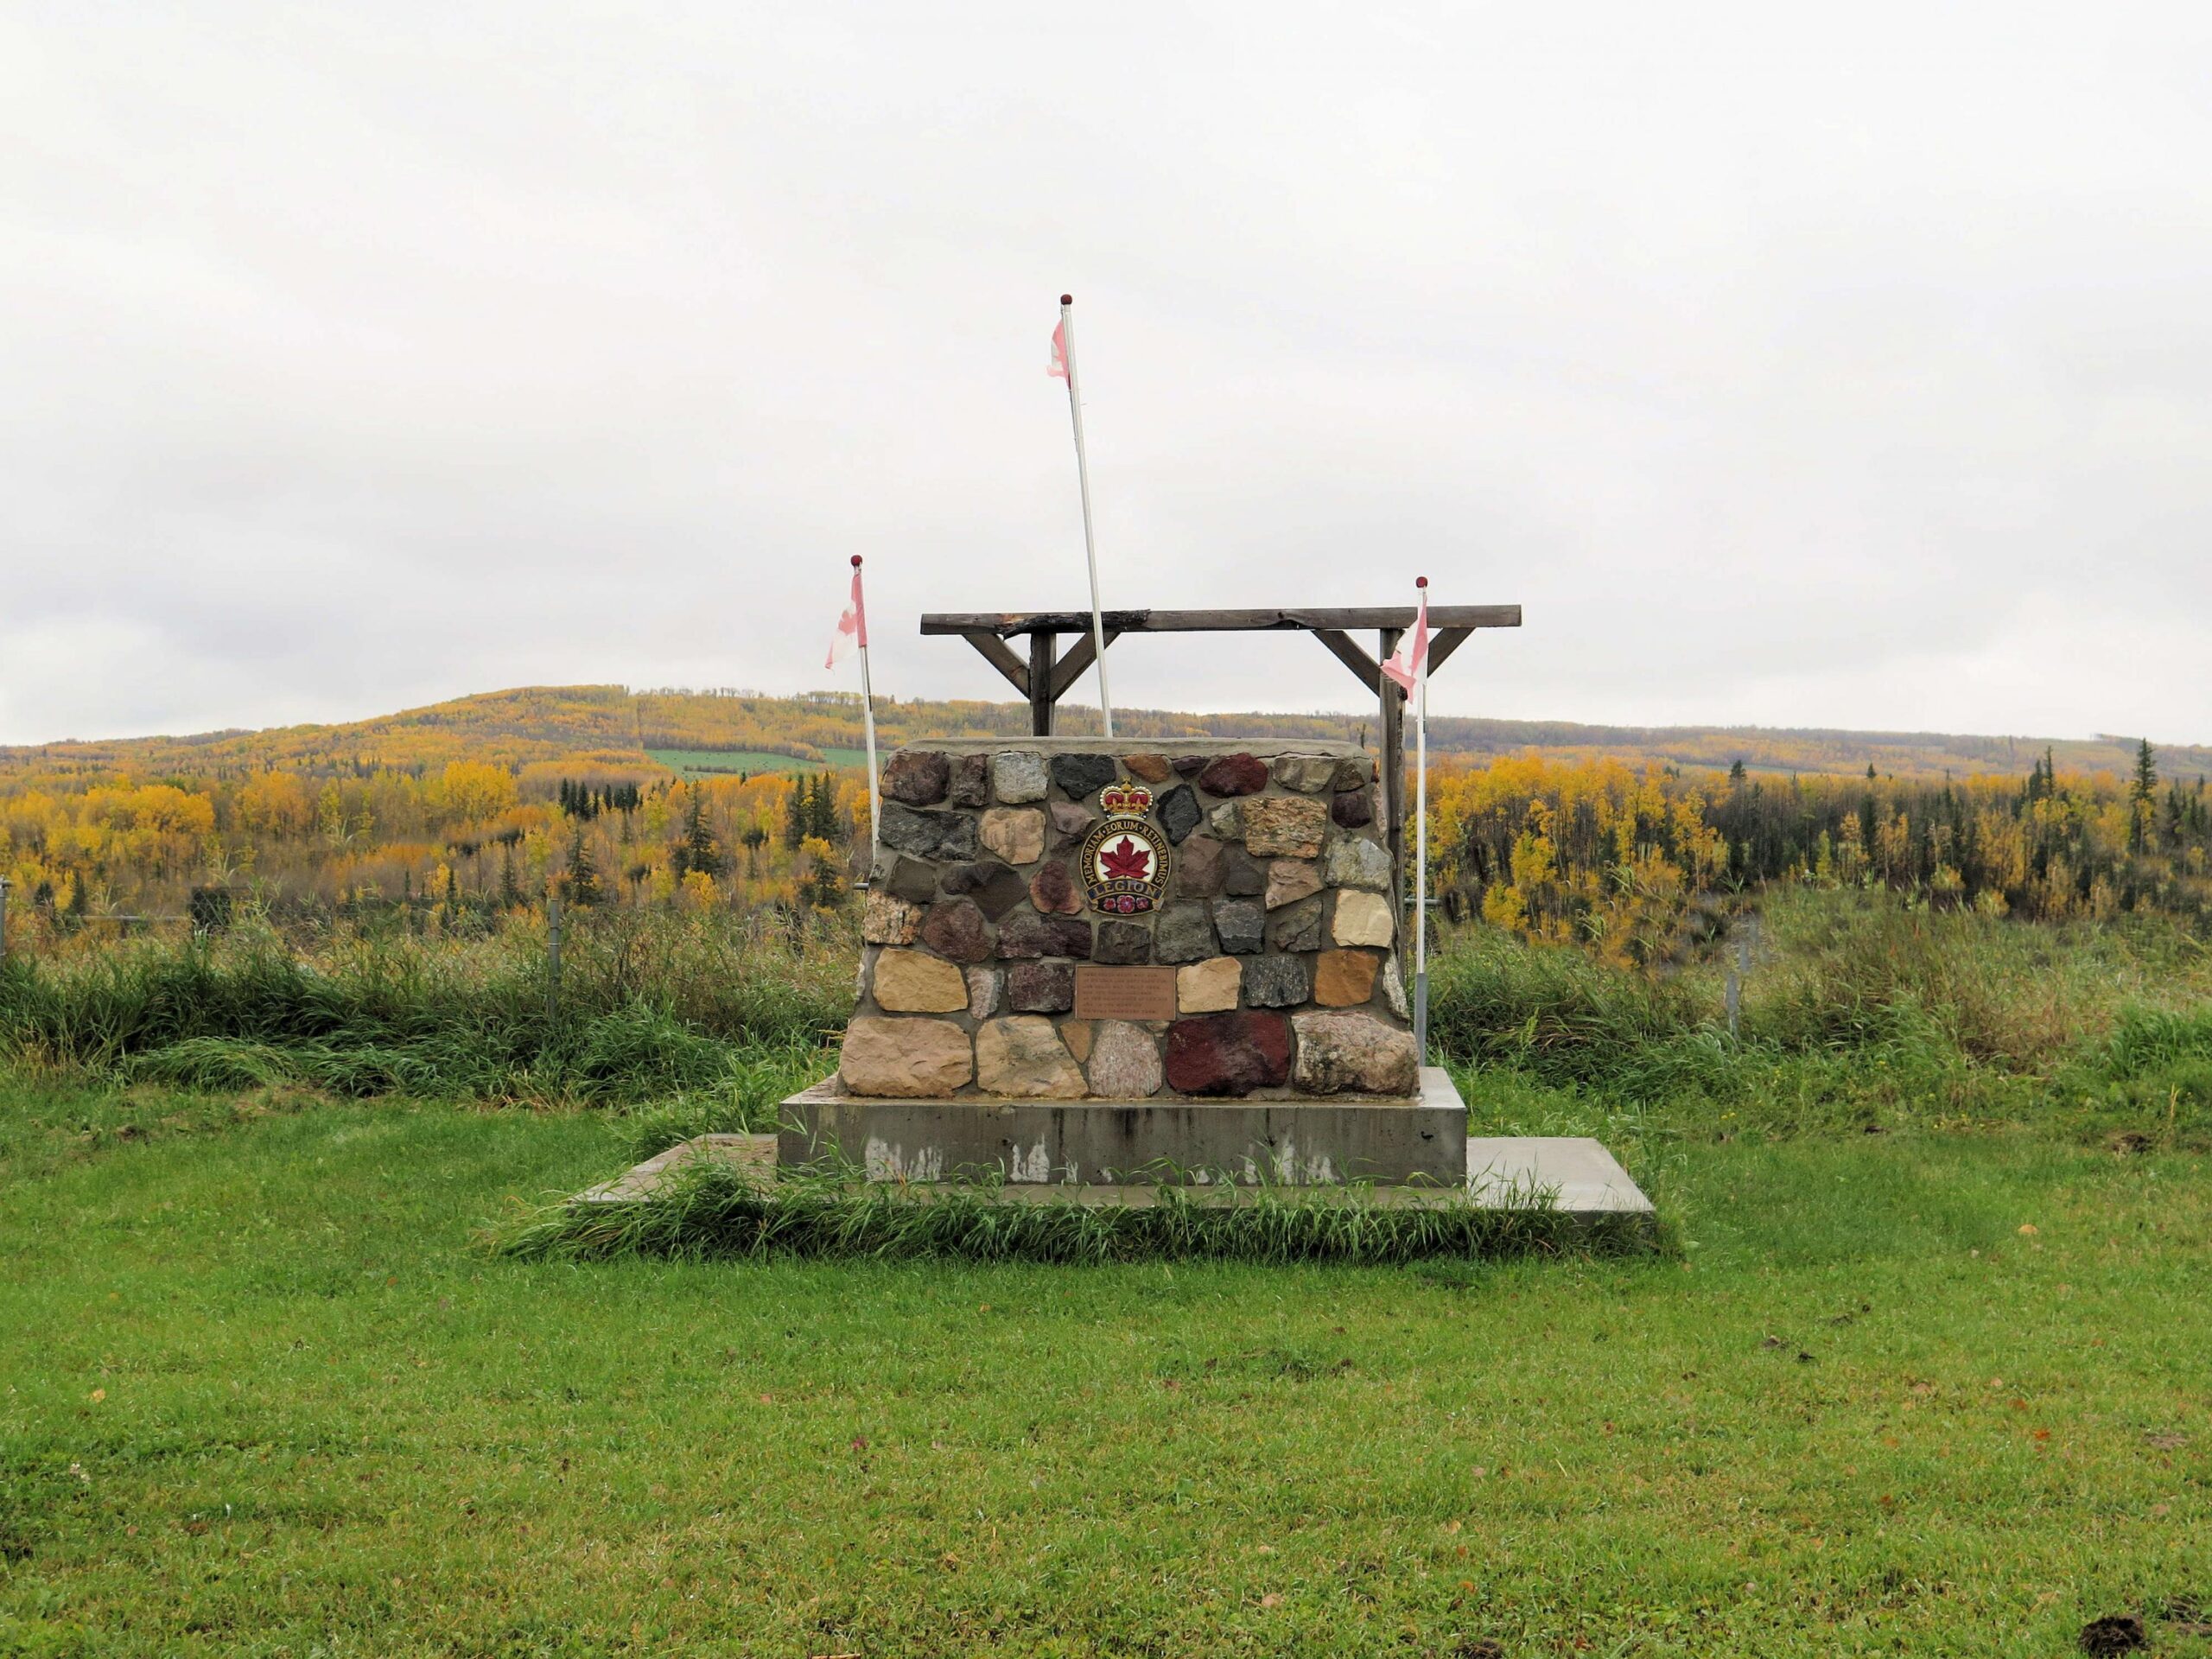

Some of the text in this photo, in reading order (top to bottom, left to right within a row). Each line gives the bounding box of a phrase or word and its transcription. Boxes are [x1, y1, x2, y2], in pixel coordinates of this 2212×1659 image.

[1083, 821, 1168, 886] MEMORIAM EORUM RETINEBIMUS
[1094, 881, 1158, 897] LEGION
